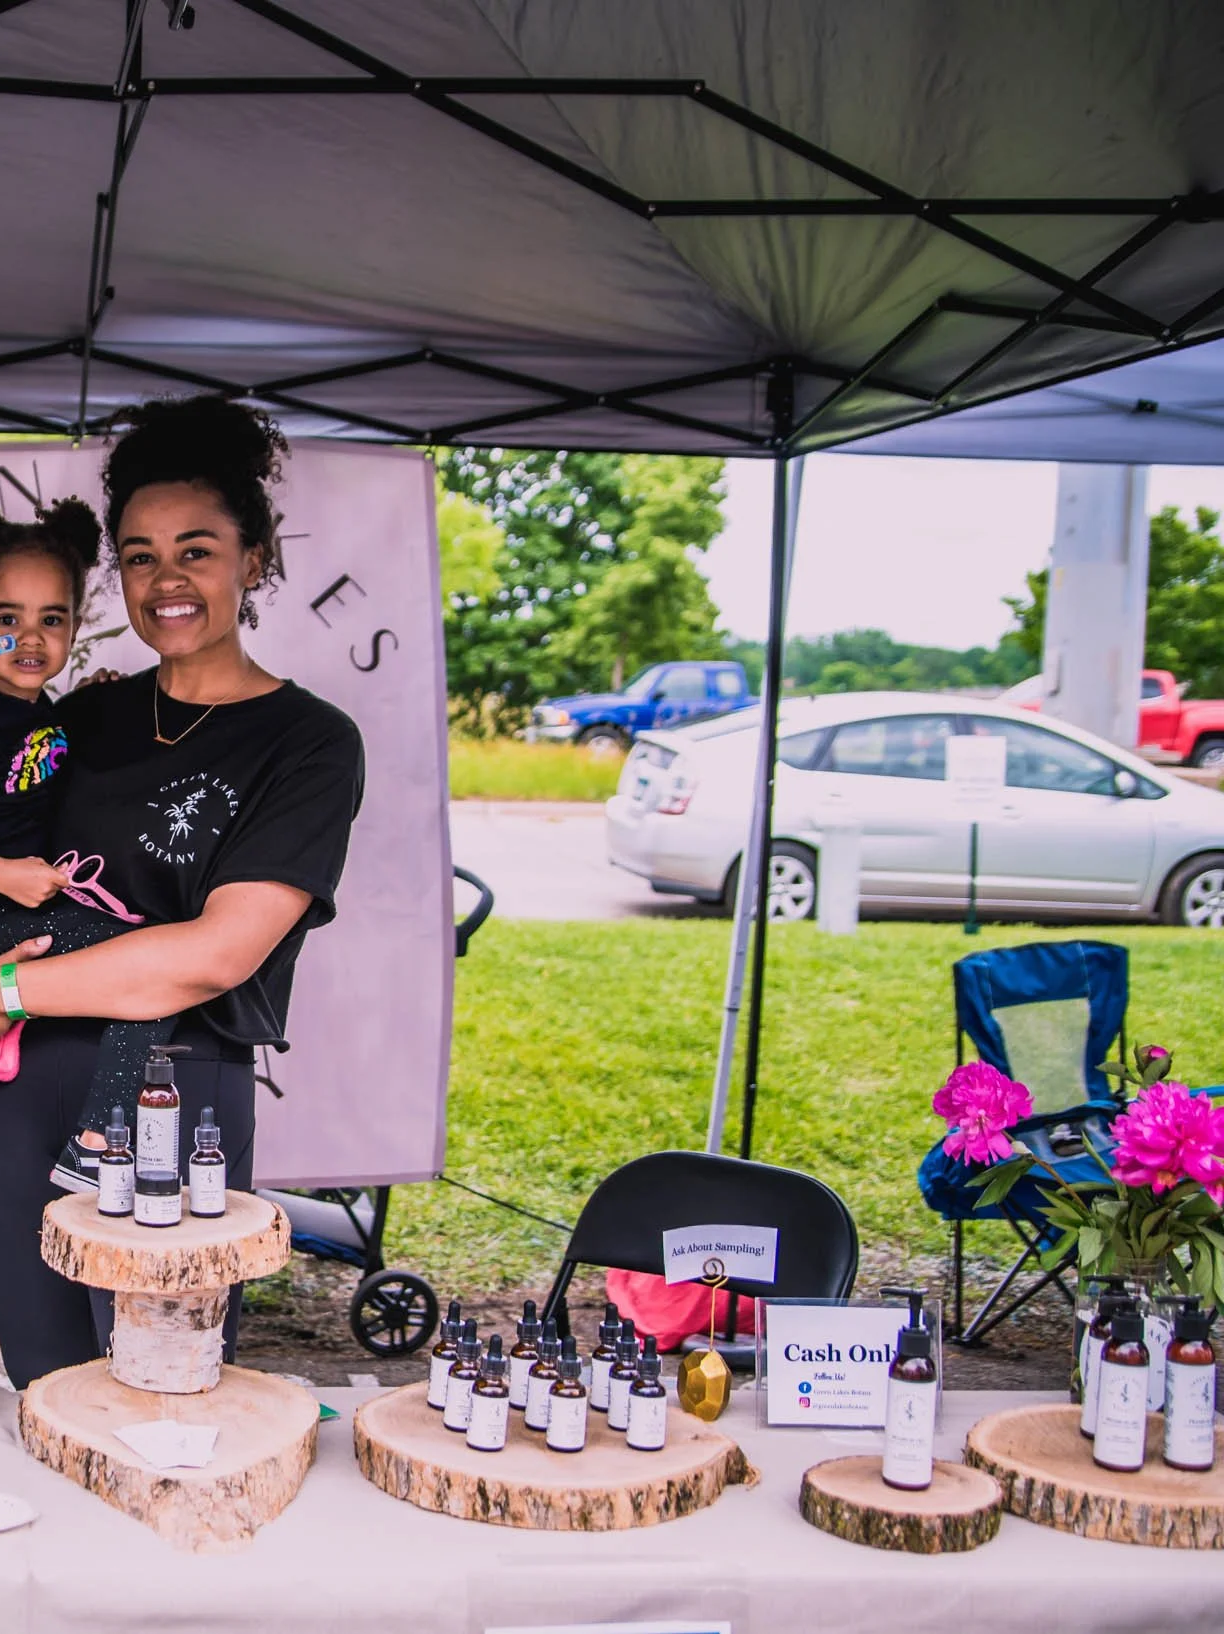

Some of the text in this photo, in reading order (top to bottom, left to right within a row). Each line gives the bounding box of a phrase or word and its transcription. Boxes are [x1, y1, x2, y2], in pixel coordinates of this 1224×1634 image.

[212, 778, 239, 817] LAKES
[138, 833, 195, 864] BOTANY
[672, 1242, 765, 1257] Ask About Sampling!
[784, 1343, 841, 1363] Cash
